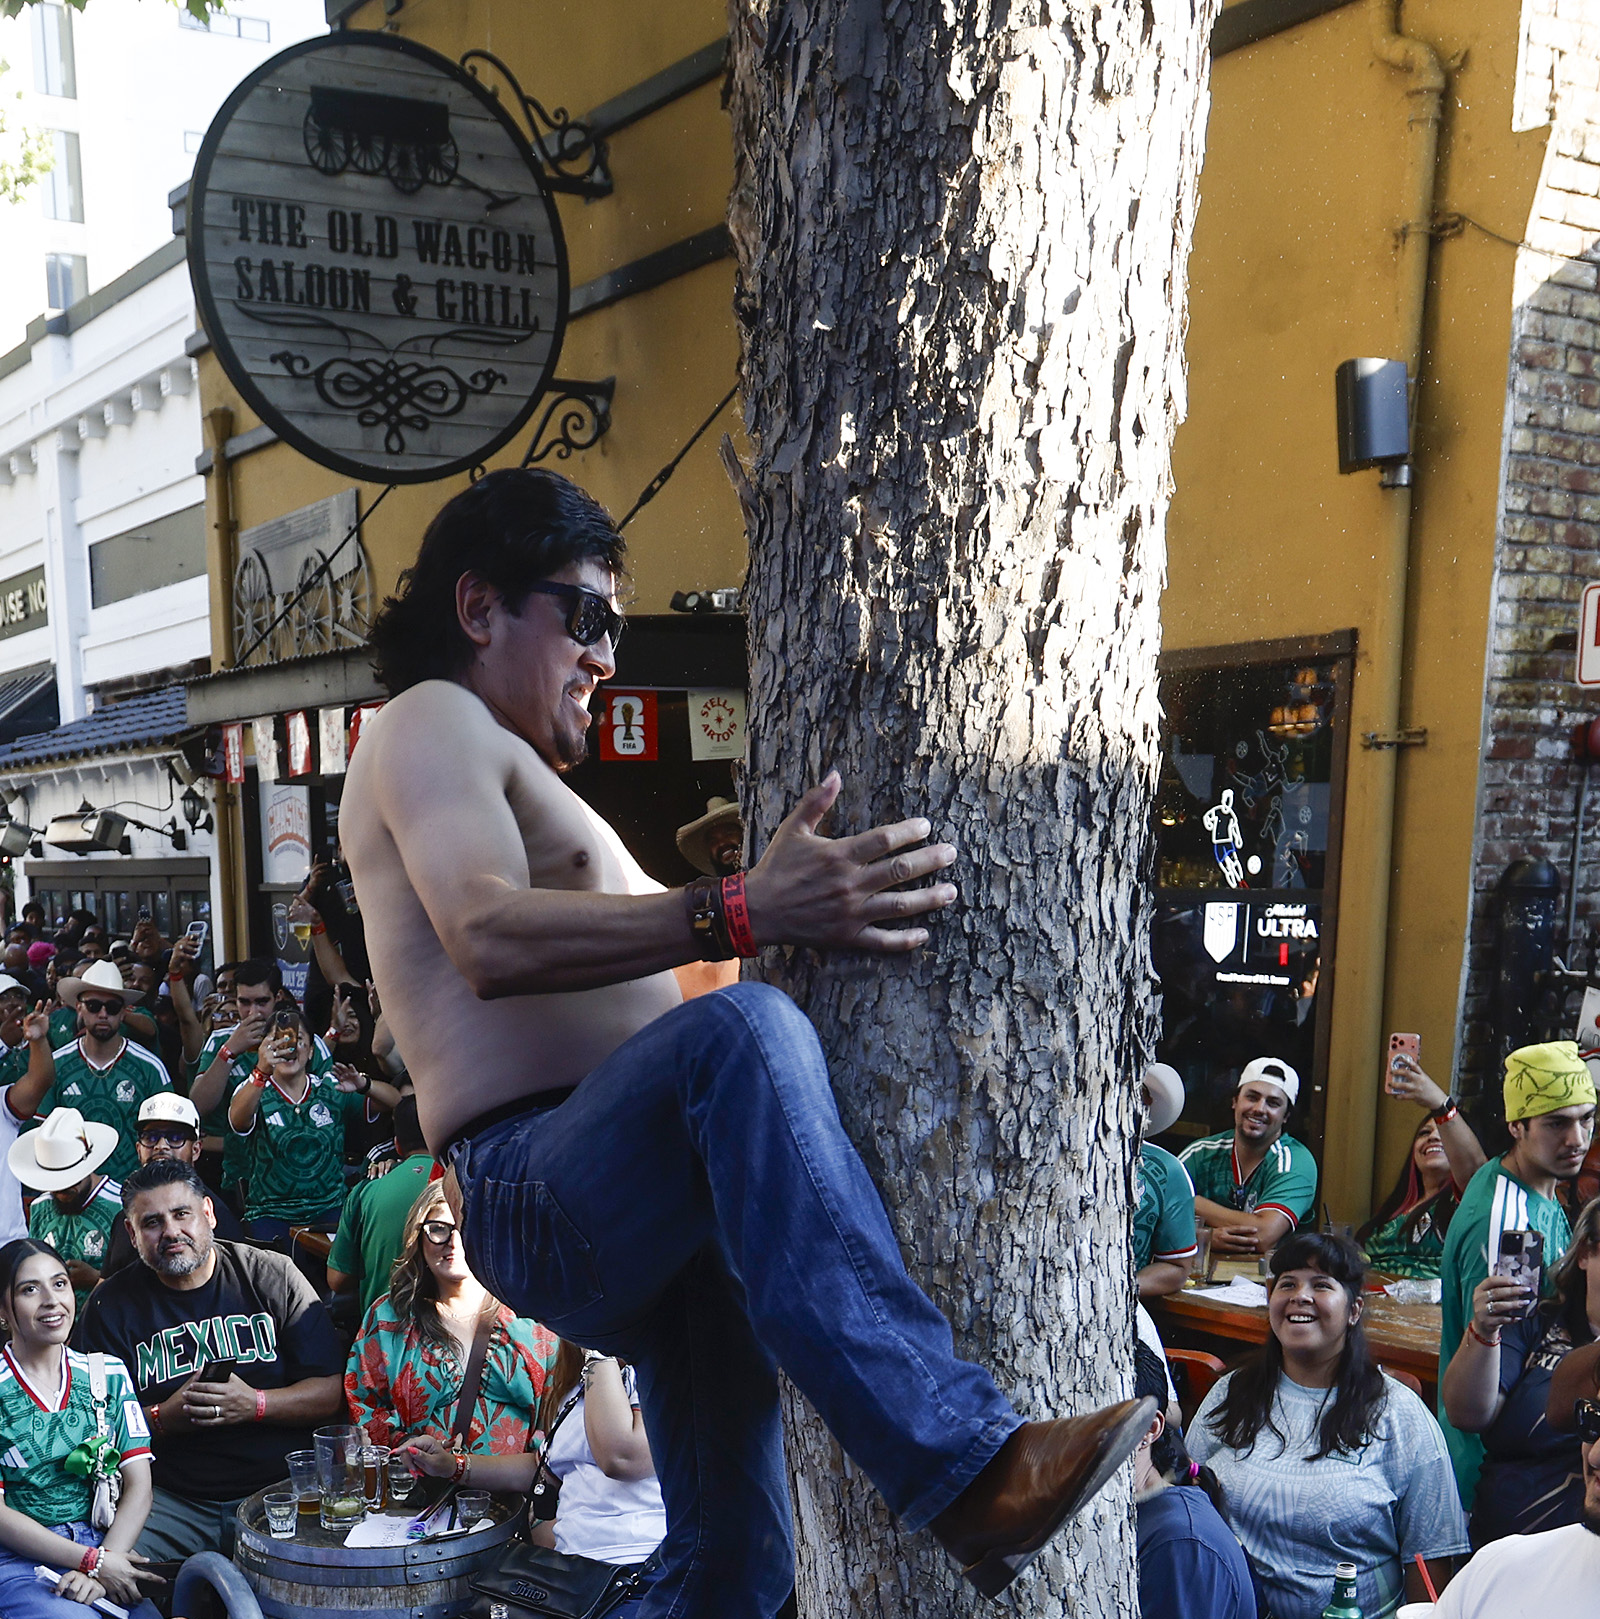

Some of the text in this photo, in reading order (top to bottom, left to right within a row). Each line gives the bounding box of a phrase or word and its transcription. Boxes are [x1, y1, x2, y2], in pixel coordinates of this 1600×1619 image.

[232, 197, 536, 276] THE OLD WAGON
[234, 256, 540, 331] SALOON & GRILL
[701, 696, 735, 718] STELLA
[701, 720, 738, 743] ARTOIS
[622, 742, 637, 750] FIFA
[1257, 918, 1319, 939] ULTRA
[136, 1314, 277, 1392] MEXICO
[510, 1579, 548, 1602] Juicy
